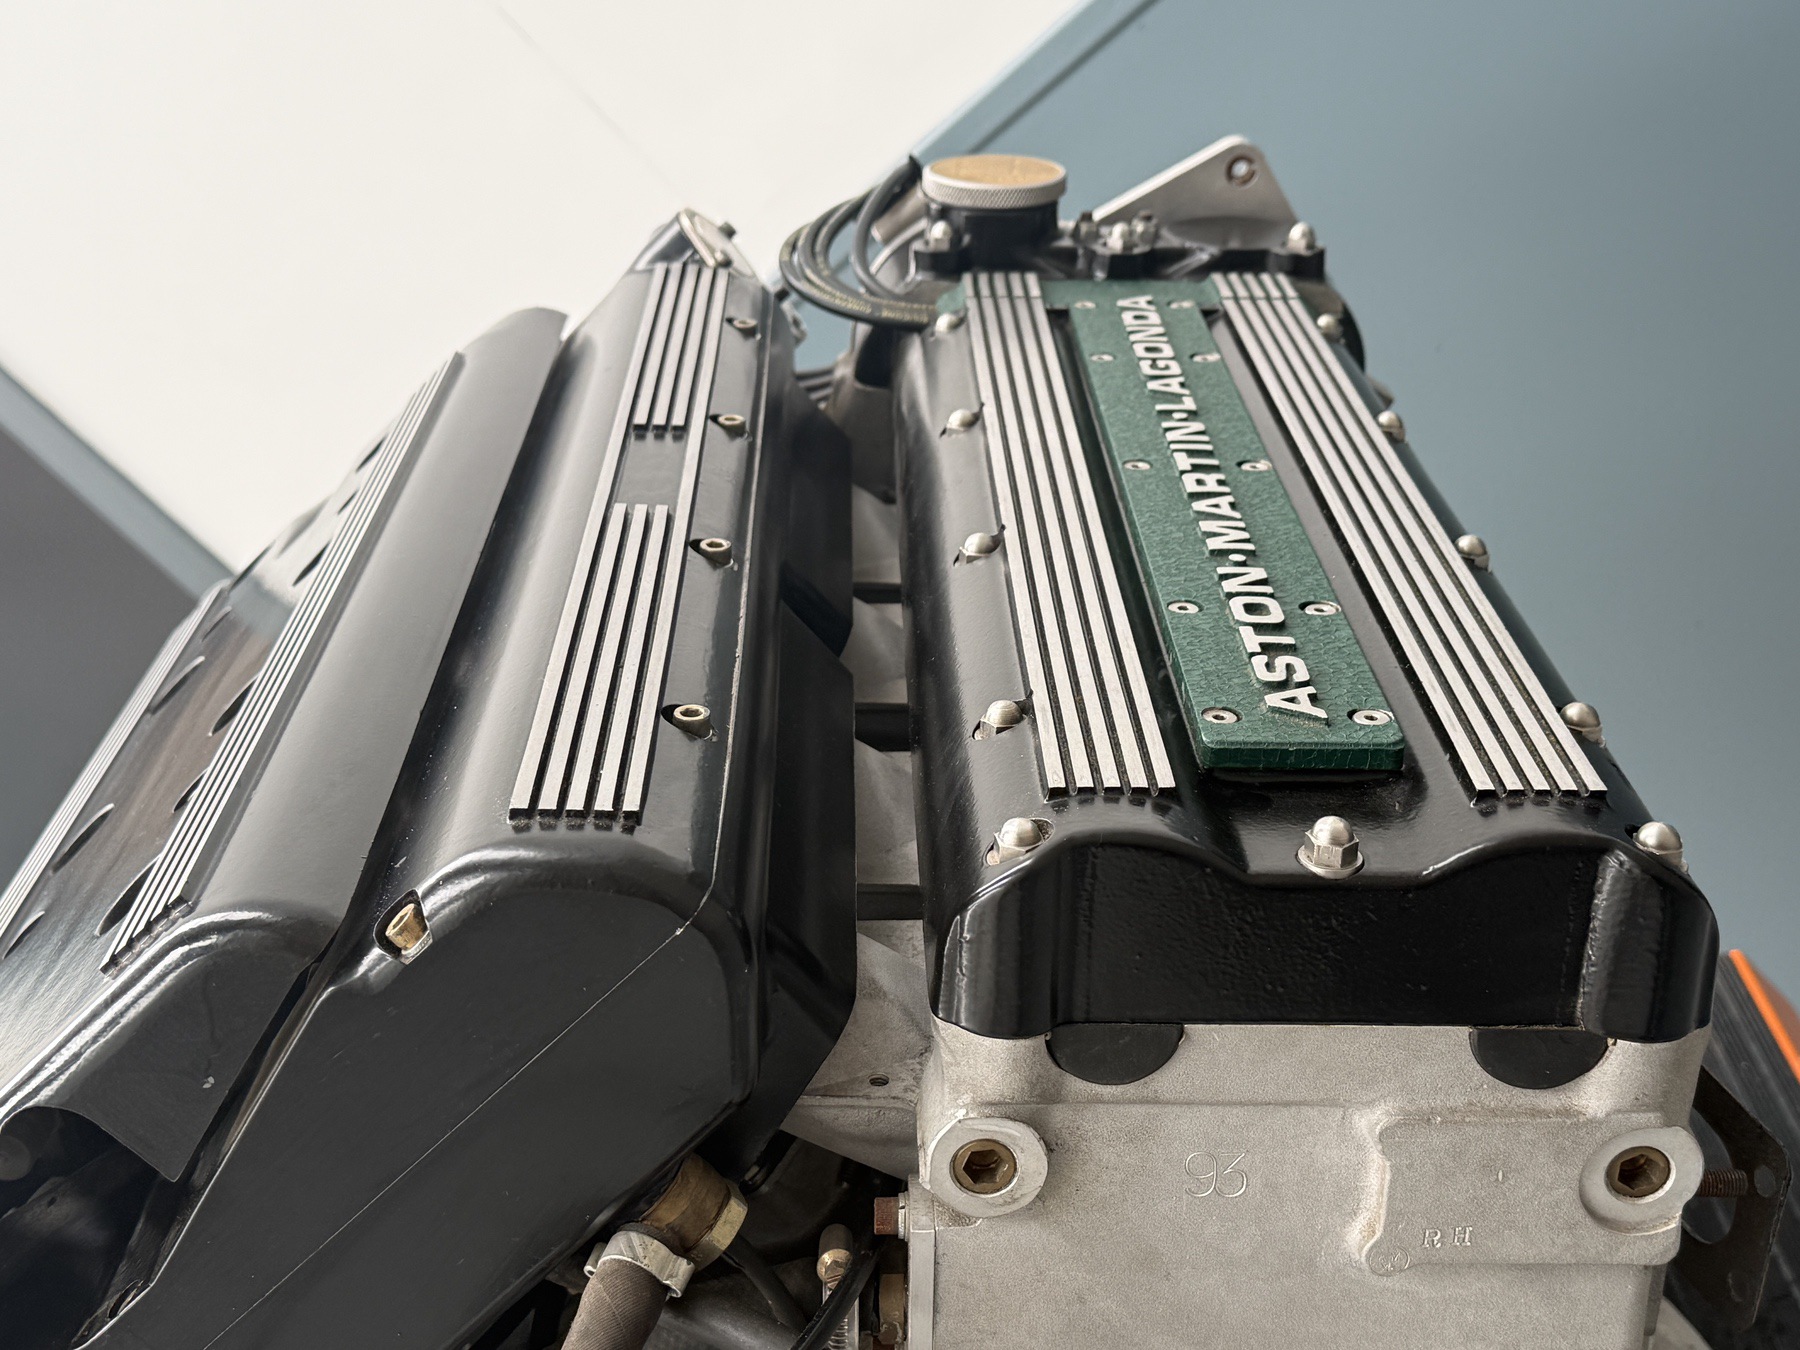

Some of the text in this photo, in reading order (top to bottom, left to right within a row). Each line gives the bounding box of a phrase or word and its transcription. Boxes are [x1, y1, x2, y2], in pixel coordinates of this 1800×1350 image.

[1116, 295, 1329, 723] ASTON MARTIN LAGONDA
[1184, 1151, 1248, 1198] 93
